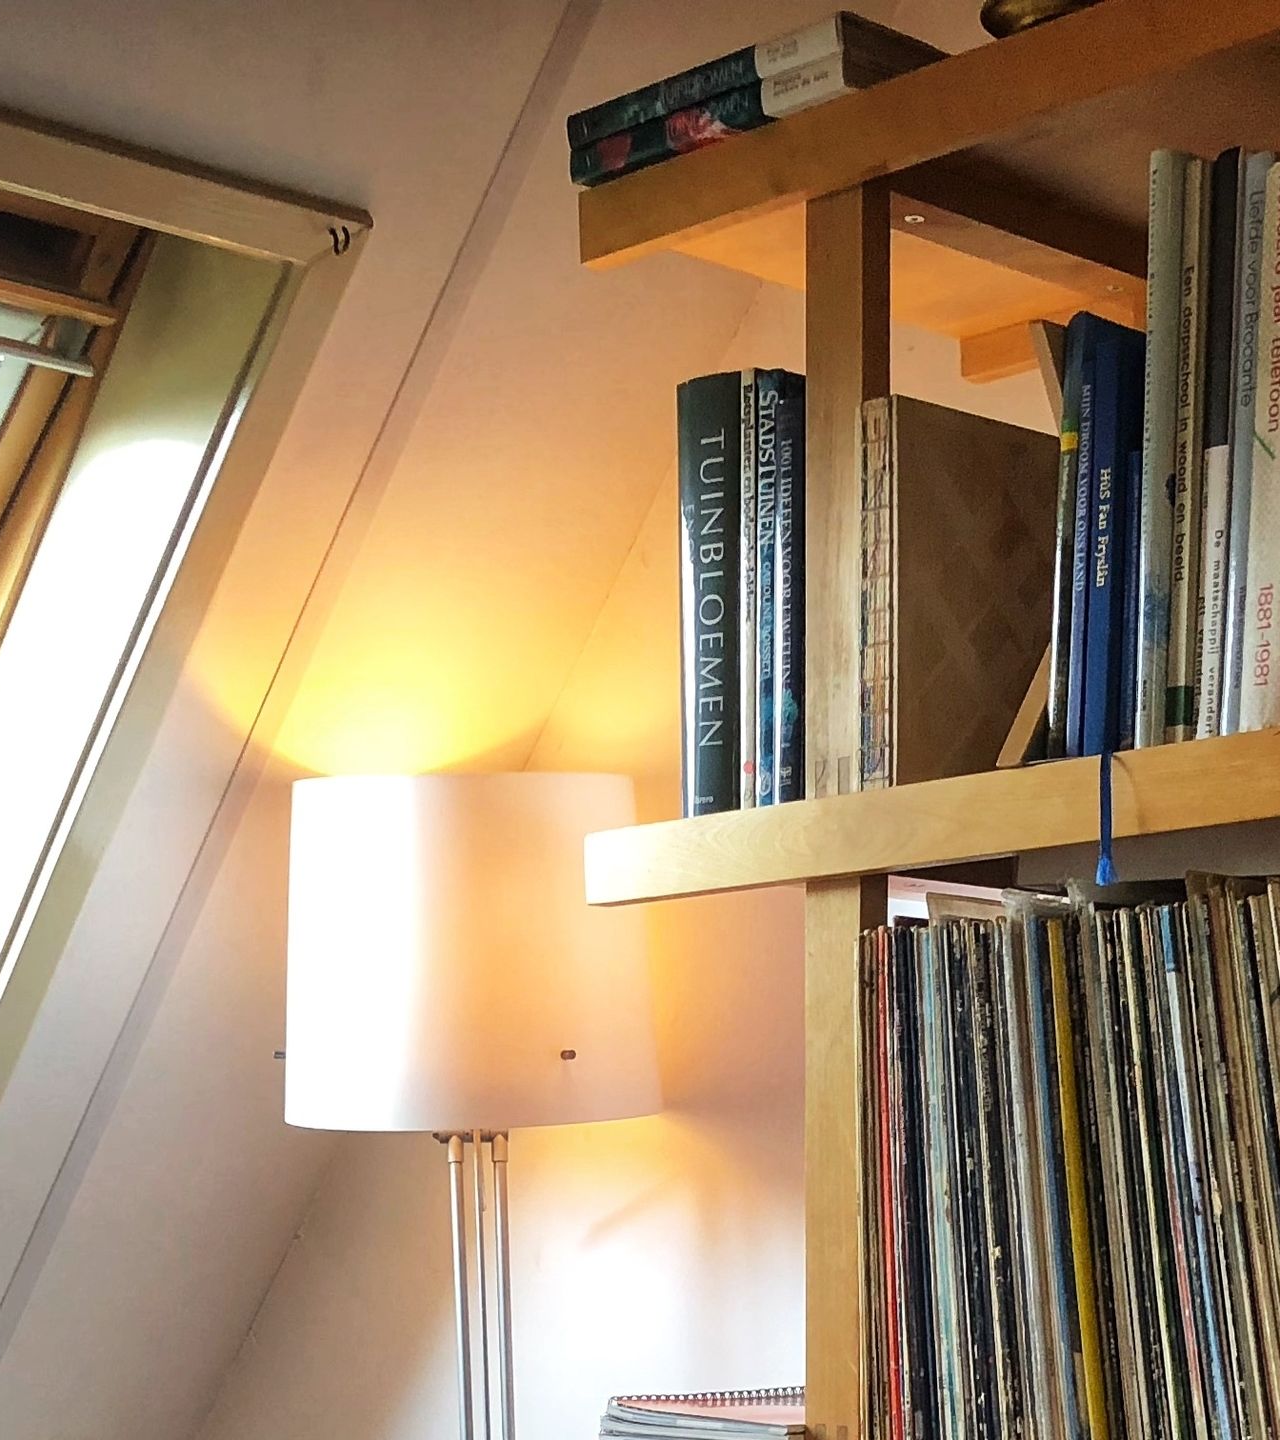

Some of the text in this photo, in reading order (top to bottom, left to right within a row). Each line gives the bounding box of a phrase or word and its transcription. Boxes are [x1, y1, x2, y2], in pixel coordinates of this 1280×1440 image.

[1240, 190, 1265, 408] Liefde voor Brocante
[758, 389, 779, 545] STADSTUINEN
[1176, 441, 1190, 494] woord
[699, 427, 725, 748] TUINBLOEMEN
[1206, 560, 1222, 655] maatschappij
[1253, 583, 1274, 687] 1881-1981
